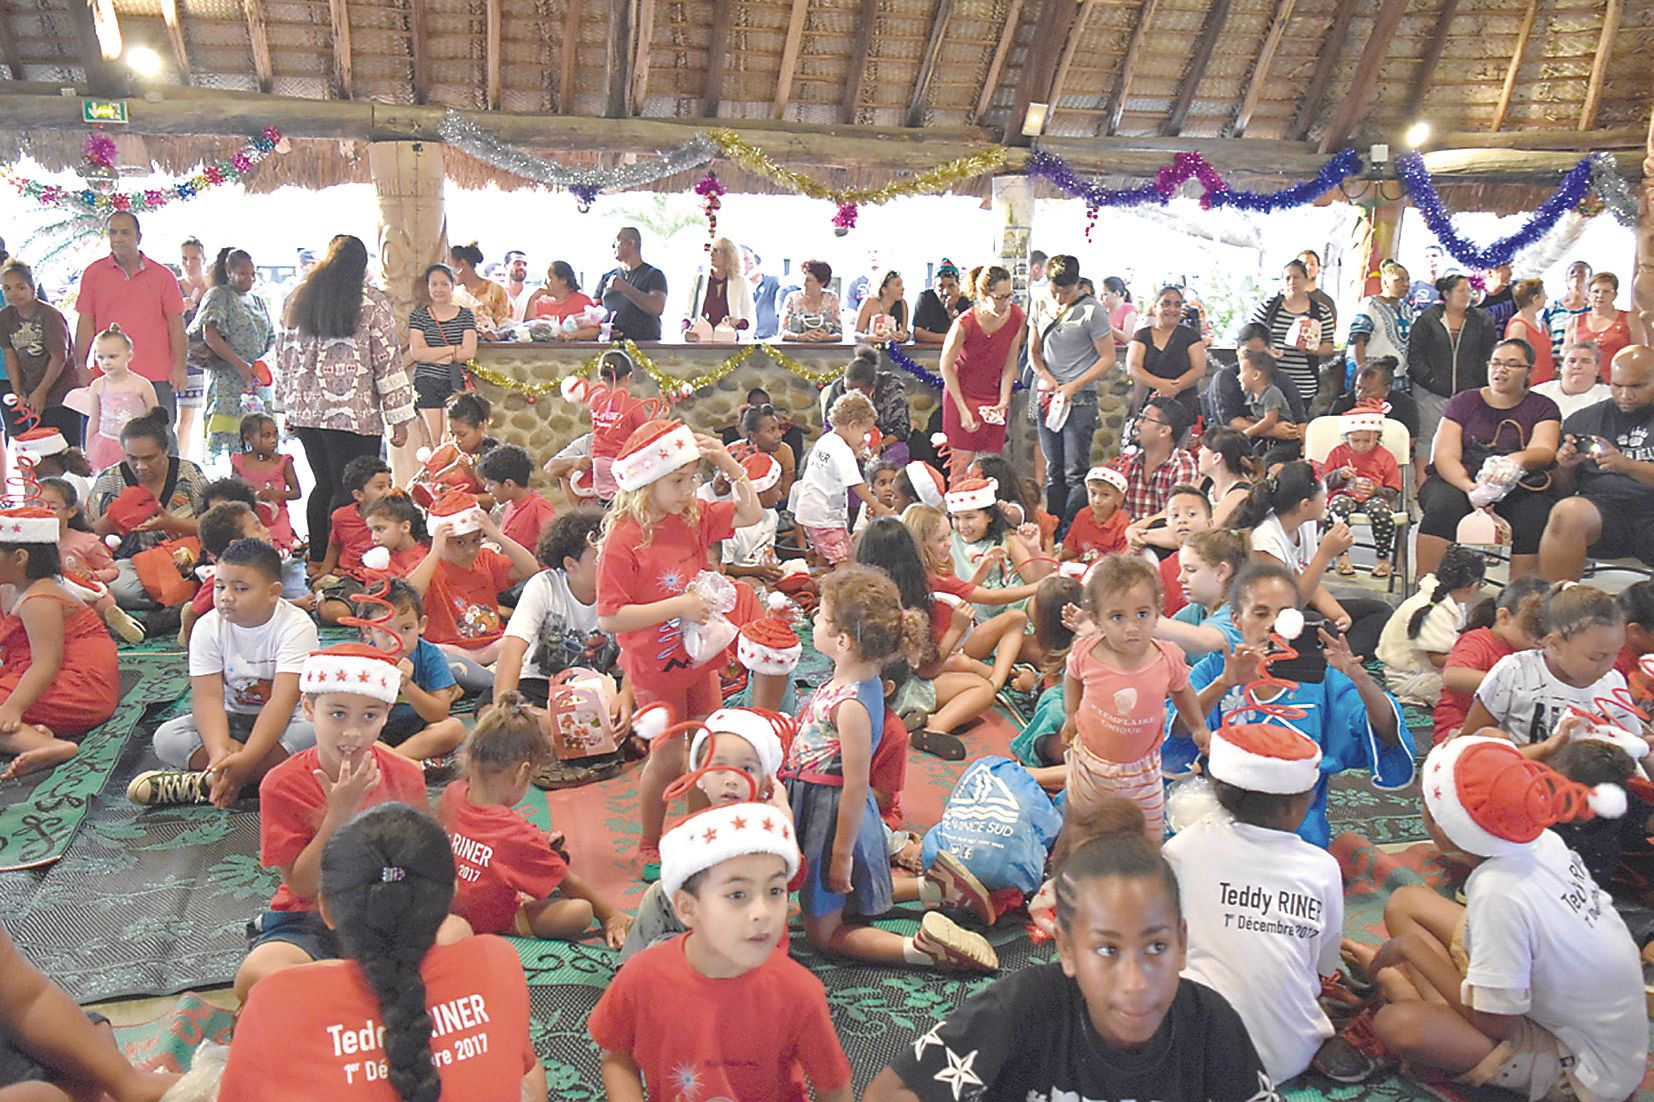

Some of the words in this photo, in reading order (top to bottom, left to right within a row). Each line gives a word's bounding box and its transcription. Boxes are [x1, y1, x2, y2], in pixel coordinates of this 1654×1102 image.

[986, 821, 1014, 837] SUD
[452, 833, 494, 868] RINER
[458, 864, 481, 882] 2017
[1219, 882, 1273, 916] Teddy
[1237, 914, 1295, 937] Décembre
[454, 1032, 489, 1061] 2017
